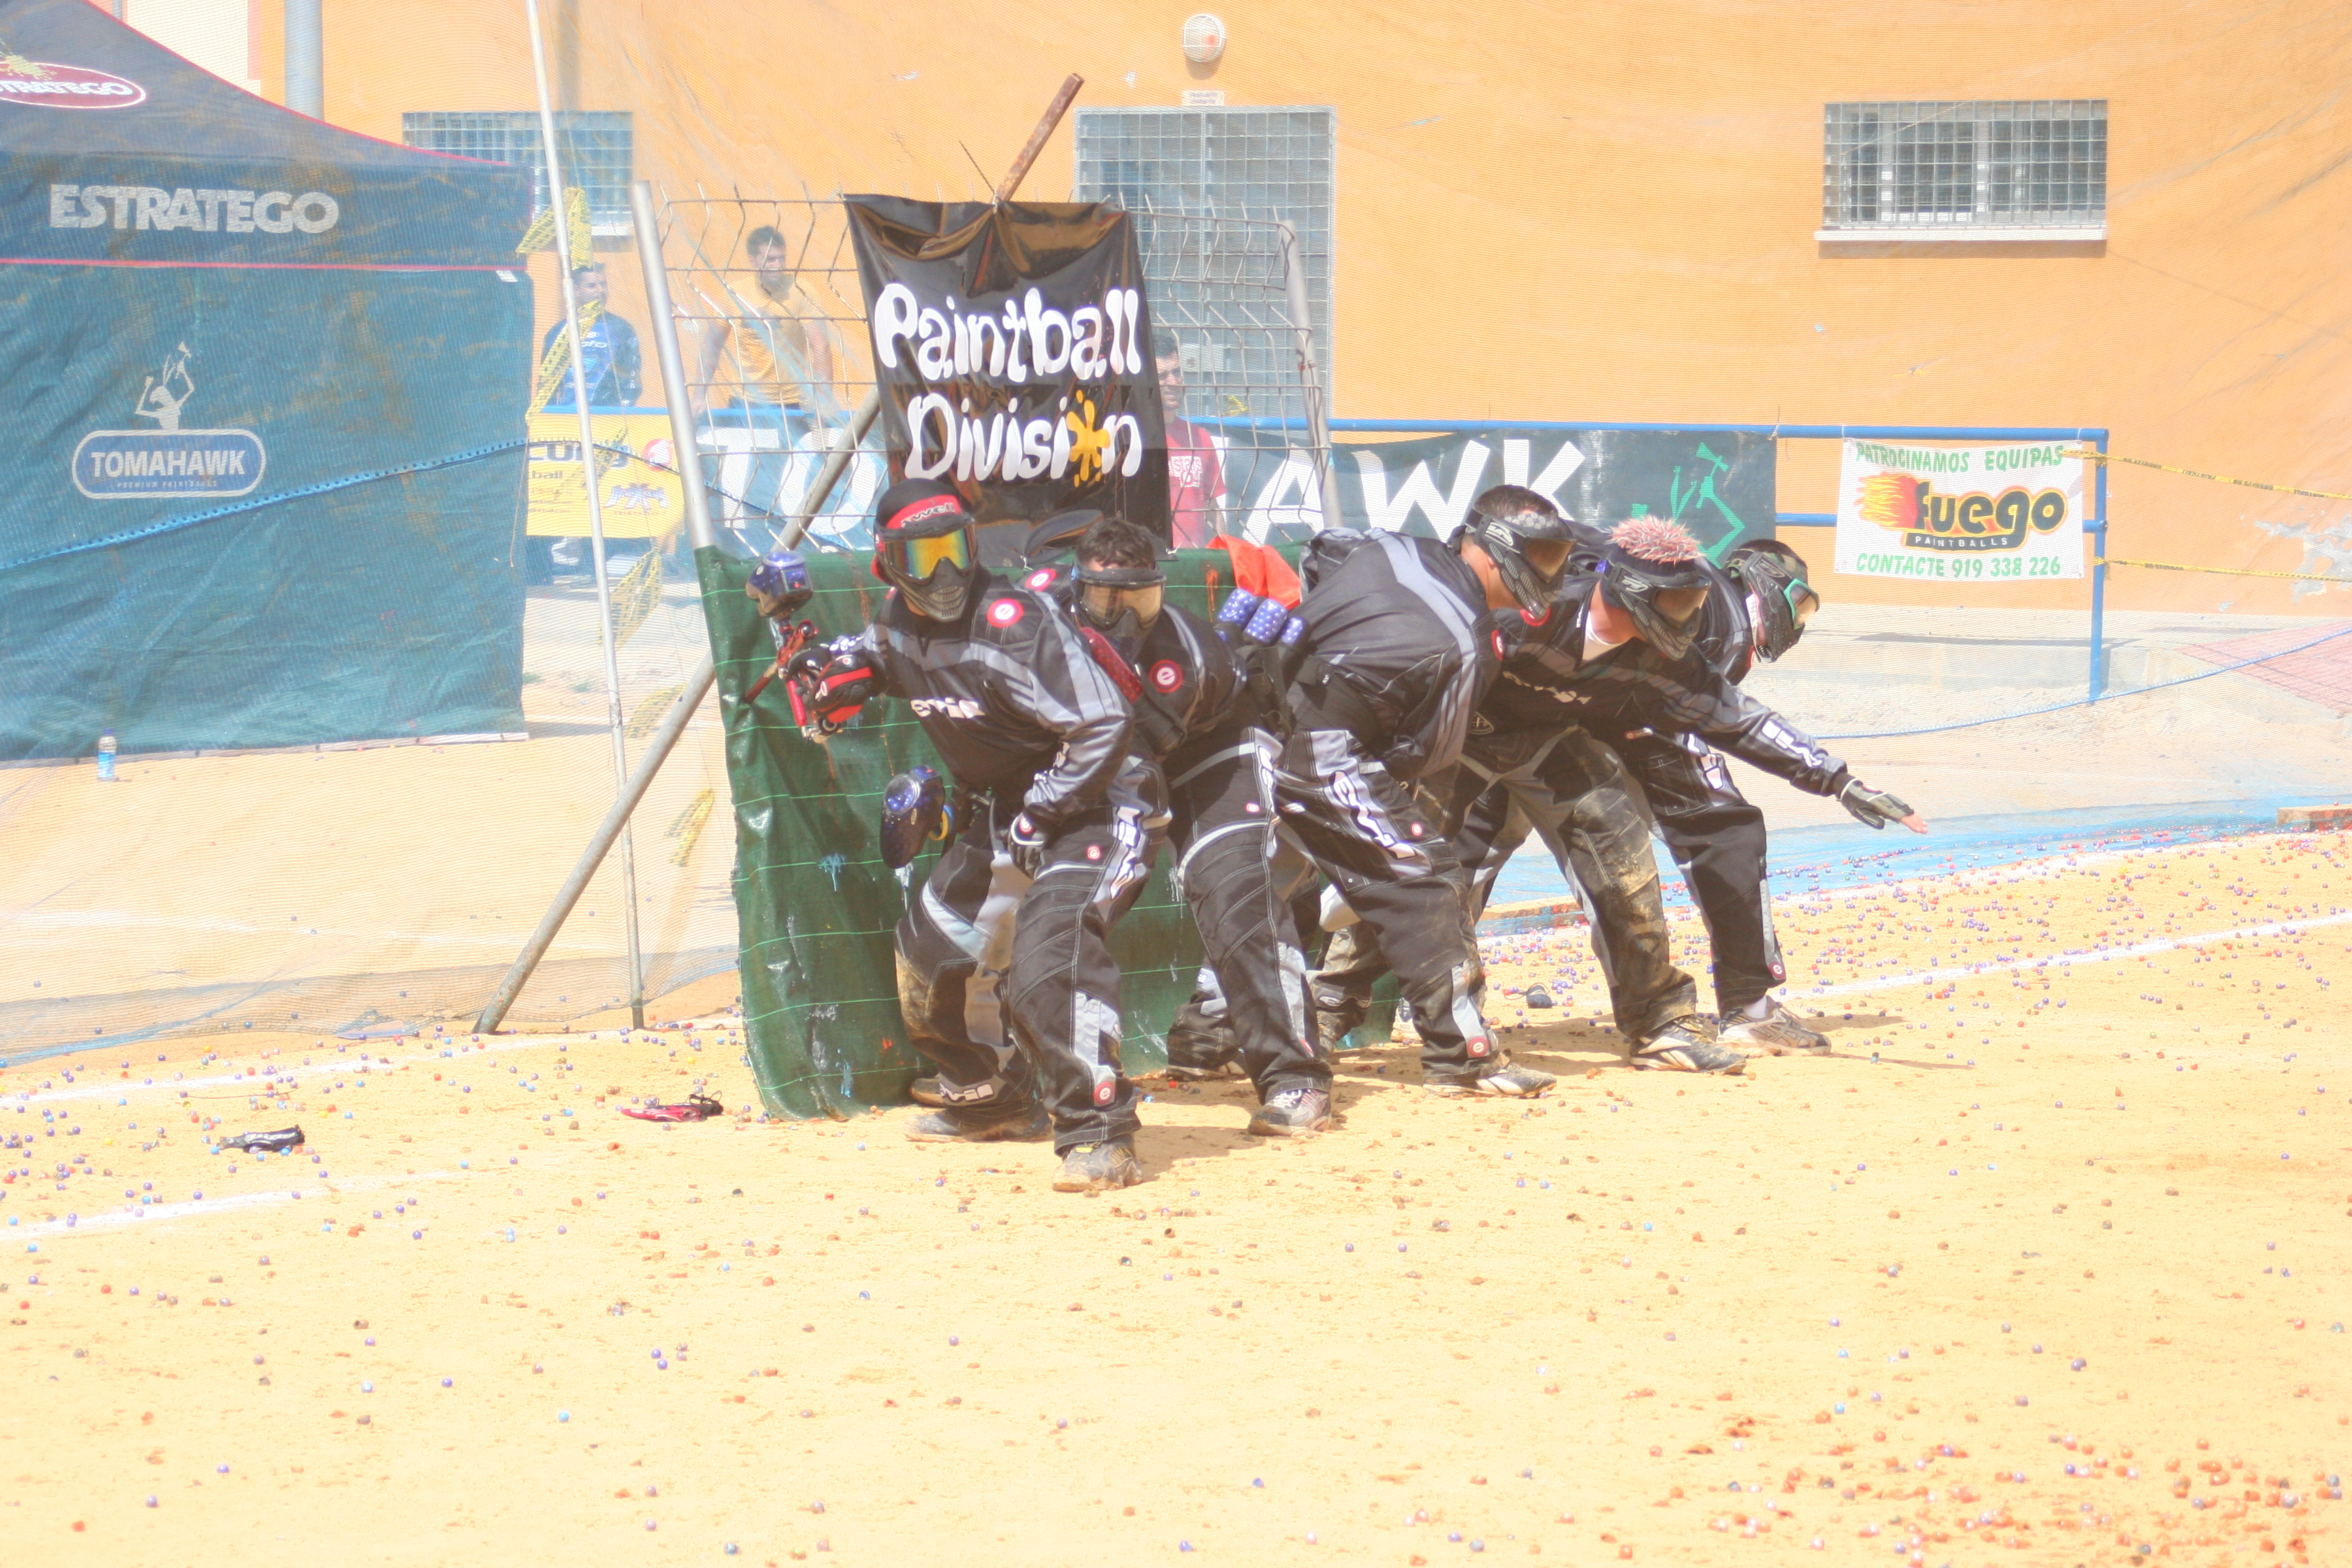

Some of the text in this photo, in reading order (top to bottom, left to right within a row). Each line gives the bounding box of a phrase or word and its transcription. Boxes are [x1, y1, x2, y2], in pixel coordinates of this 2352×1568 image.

[0, 80, 133, 95] TRATEGO
[50, 184, 340, 233] ESTRATEGO
[875, 282, 1141, 382] Paintball
[91, 450, 246, 478] TOMAHAWK
[1856, 443, 2063, 473] PATROCINAMOS EQUIPAS
[163, 480, 217, 488] PAINTBALLS
[1914, 481, 2065, 546] fuego
[1915, 535, 2008, 547] PAINTBALLS
[1856, 553, 2061, 578] CONTACTE 919 338 226
